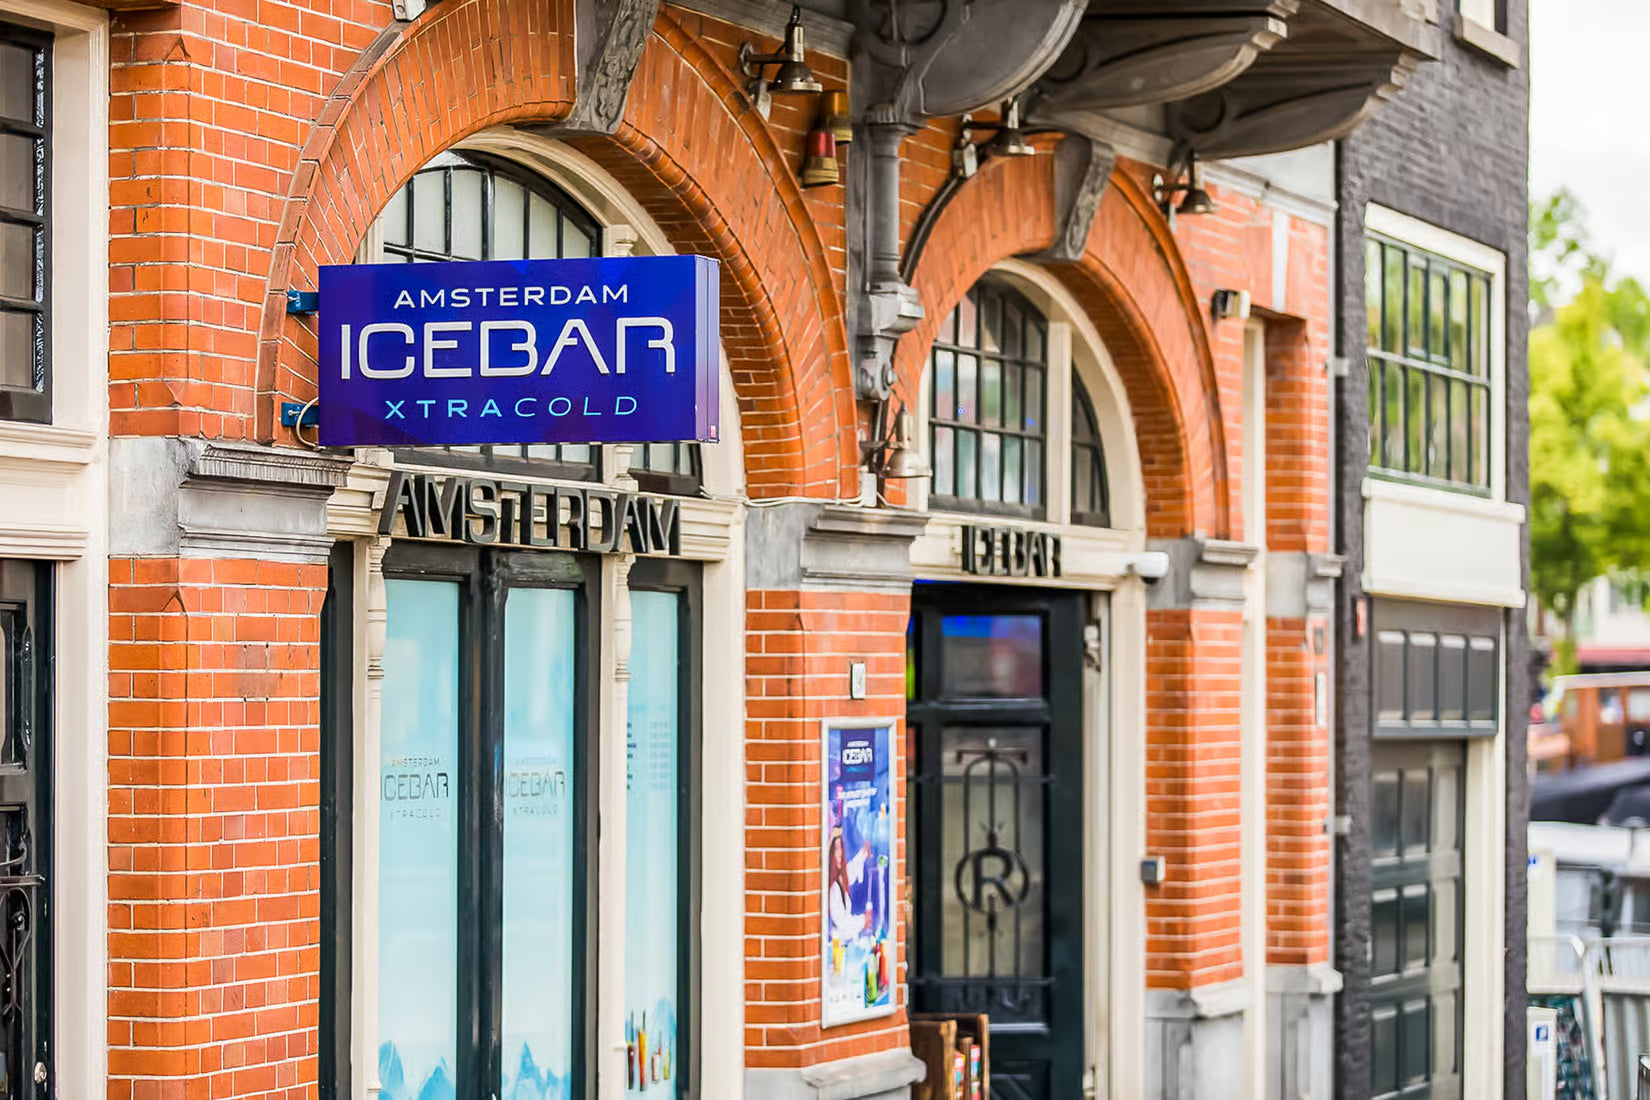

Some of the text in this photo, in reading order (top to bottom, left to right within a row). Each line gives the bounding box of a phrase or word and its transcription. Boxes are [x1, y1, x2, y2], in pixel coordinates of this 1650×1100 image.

[394, 284, 628, 309] AMSTERDAM
[340, 316, 675, 380] ICEBAR
[384, 396, 638, 419] XTRACOLD
[378, 470, 681, 556] AMSTERDAM
[961, 525, 1062, 577] ICEBAR
